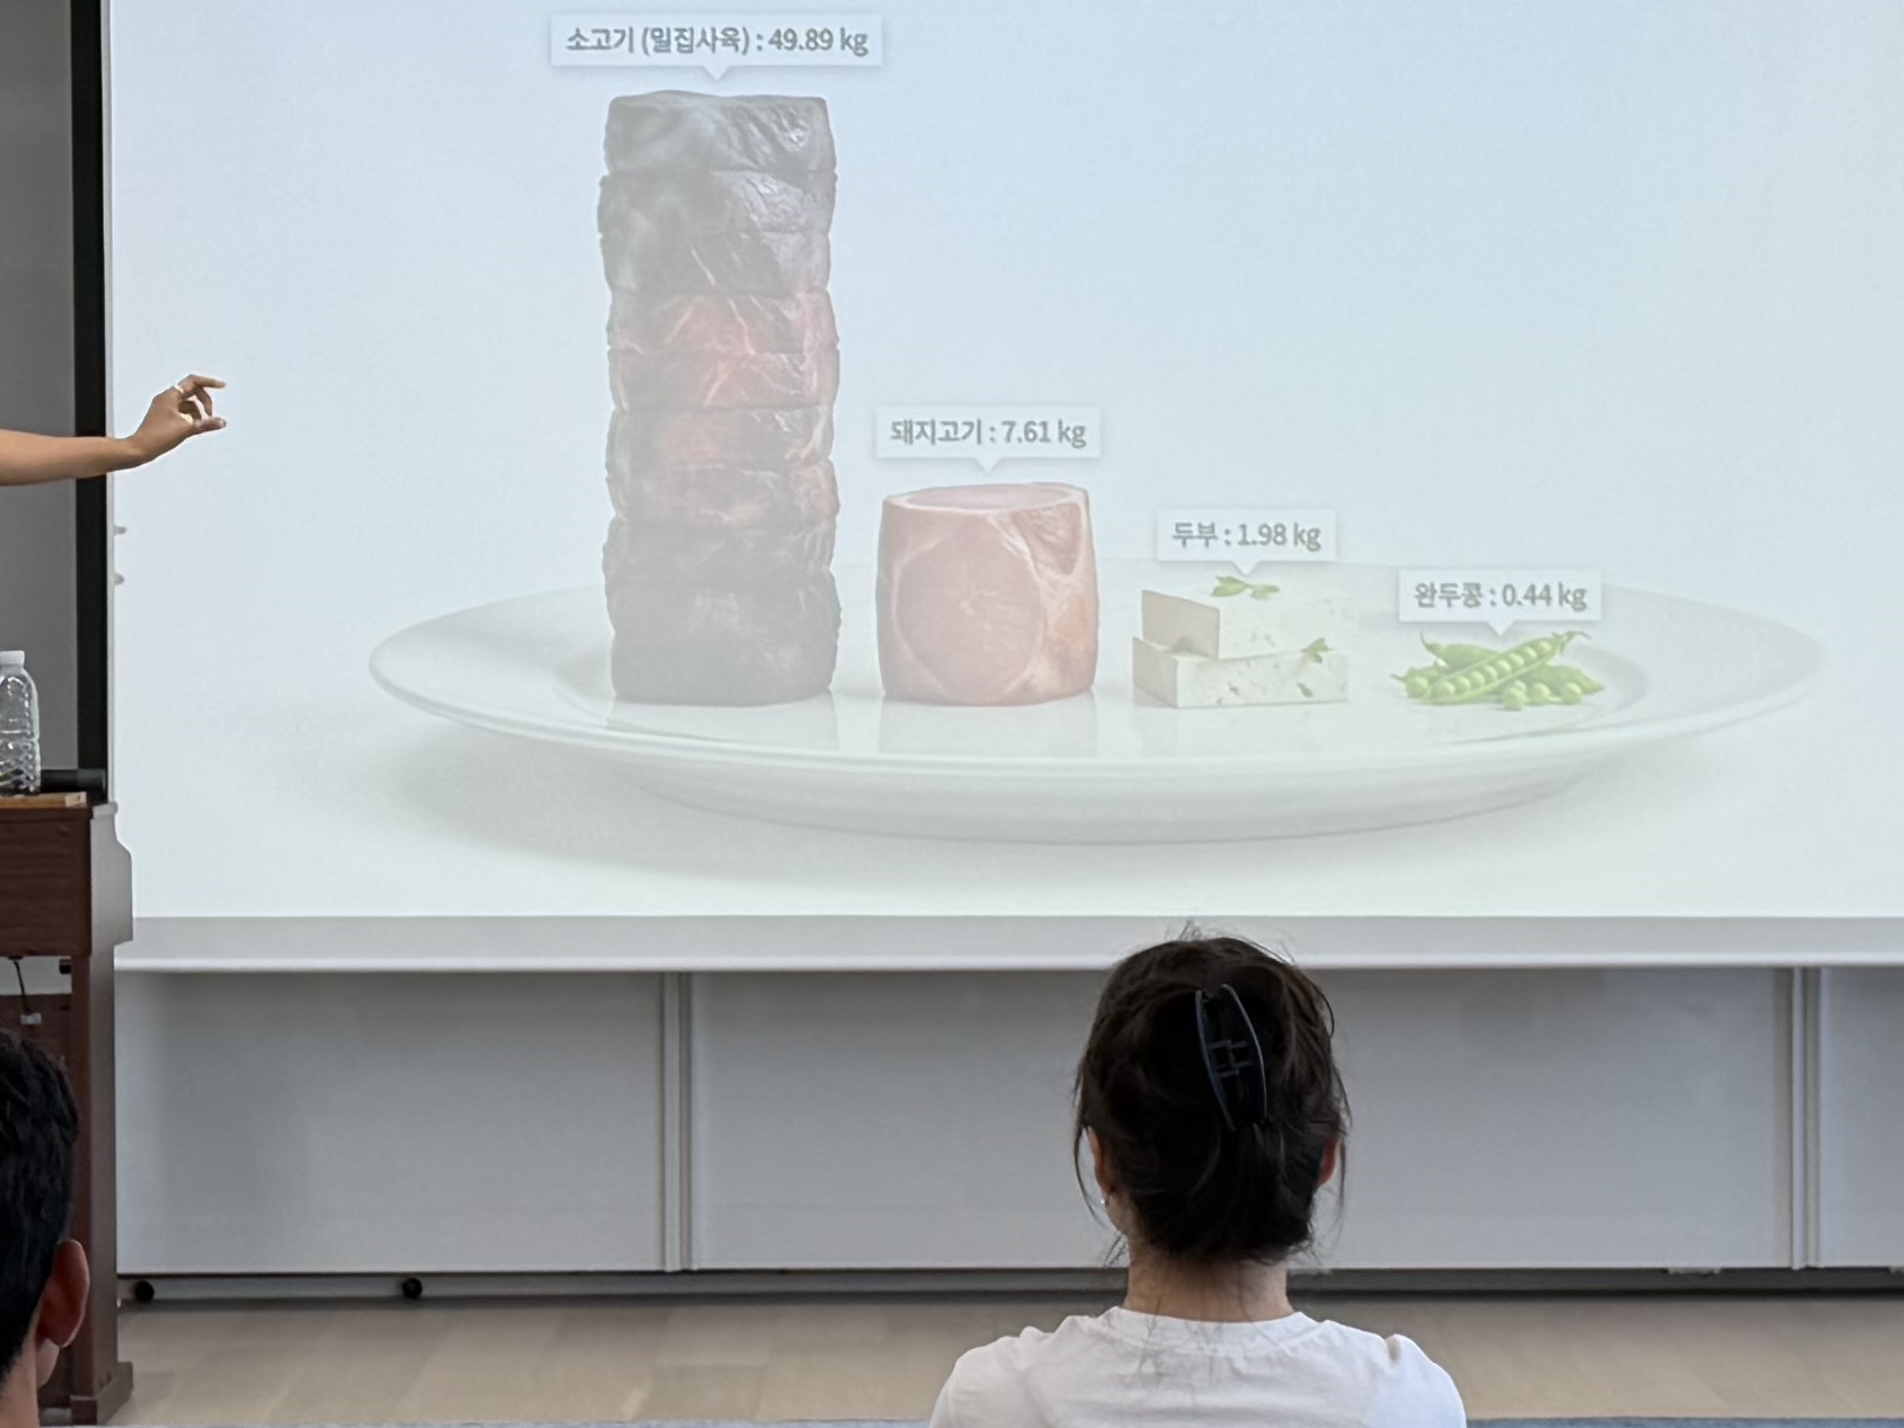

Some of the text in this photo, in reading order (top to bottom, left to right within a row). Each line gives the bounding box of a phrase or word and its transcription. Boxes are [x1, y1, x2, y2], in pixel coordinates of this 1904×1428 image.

[566, 27, 635, 53] 소고기
[641, 26, 751, 56] (밀집사육)
[768, 27, 834, 52] 49.89
[840, 26, 870, 57] kg
[890, 419, 982, 445] 돼지고기
[1001, 420, 1052, 443] 7.61
[1057, 419, 1087, 449] kg
[1172, 523, 1219, 549] 두부
[1237, 523, 1287, 546] 1.98
[1294, 522, 1322, 551] kg
[1415, 583, 1482, 609] 완두콩
[1502, 584, 1552, 607] 0.44
[1558, 583, 1587, 611] kg
